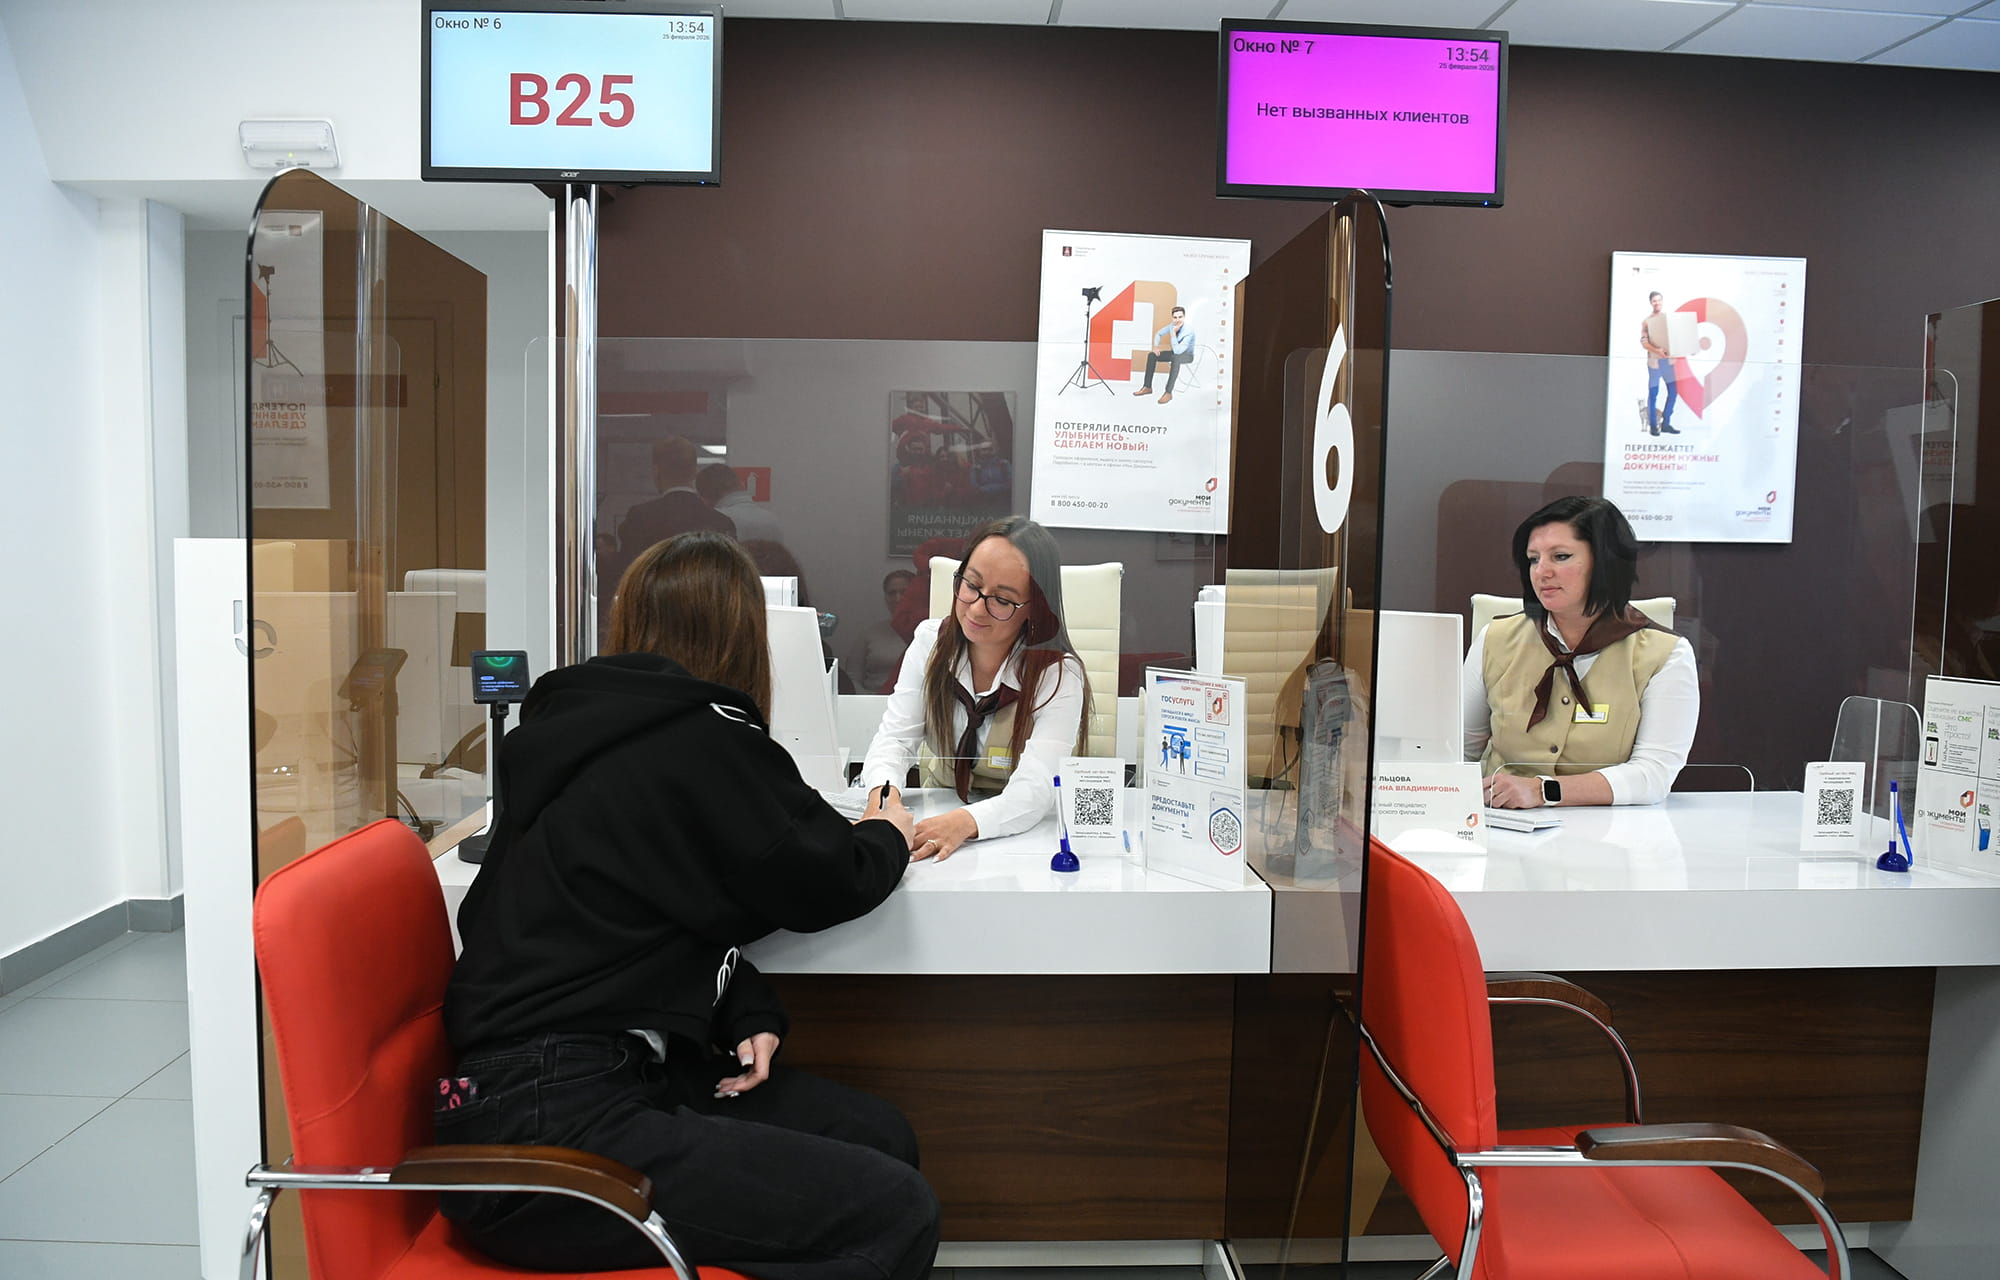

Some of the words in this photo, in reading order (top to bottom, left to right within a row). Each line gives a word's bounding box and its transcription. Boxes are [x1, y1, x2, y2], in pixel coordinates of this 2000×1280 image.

[435, 17, 469, 30] Окно
[473, 17, 489, 29] №
[493, 18, 502, 30] 6
[668, 21, 704, 33] 13:54
[1233, 37, 1276, 53] Окно
[1280, 39, 1299, 53] №
[1304, 41, 1315, 55] 7
[1446, 47, 1489, 62] 13:54
[1257, 103, 1287, 117] Нет
[1293, 106, 1388, 121] вызванных
[1393, 109, 1470, 125] клиентов
[560, 170, 580, 178] acer
[1055, 421, 1111, 432] ПОТЕРЯЛИ
[1113, 423, 1167, 435] ПАСПОРТ?
[1313, 322, 1355, 534] 6
[1054, 431, 1124, 441] УЛЫБНИТЕСЬ
[1054, 440, 1104, 449] СДЕЛАЕМ
[1106, 441, 1149, 451] НОВЫЙ!
[1625, 444, 1694, 452] ПЕРЕЕЗЖАЕТЕ?
[1624, 453, 1676, 461] ОФОРМИМ
[1678, 454, 1720, 462] НУЖНЫЕ
[1072, 500, 1109, 509] 450-00-20
[1152, 794, 1195, 810] ПРЕДОСТАВЬТЕ
[1948, 809, 1966, 817] мои
